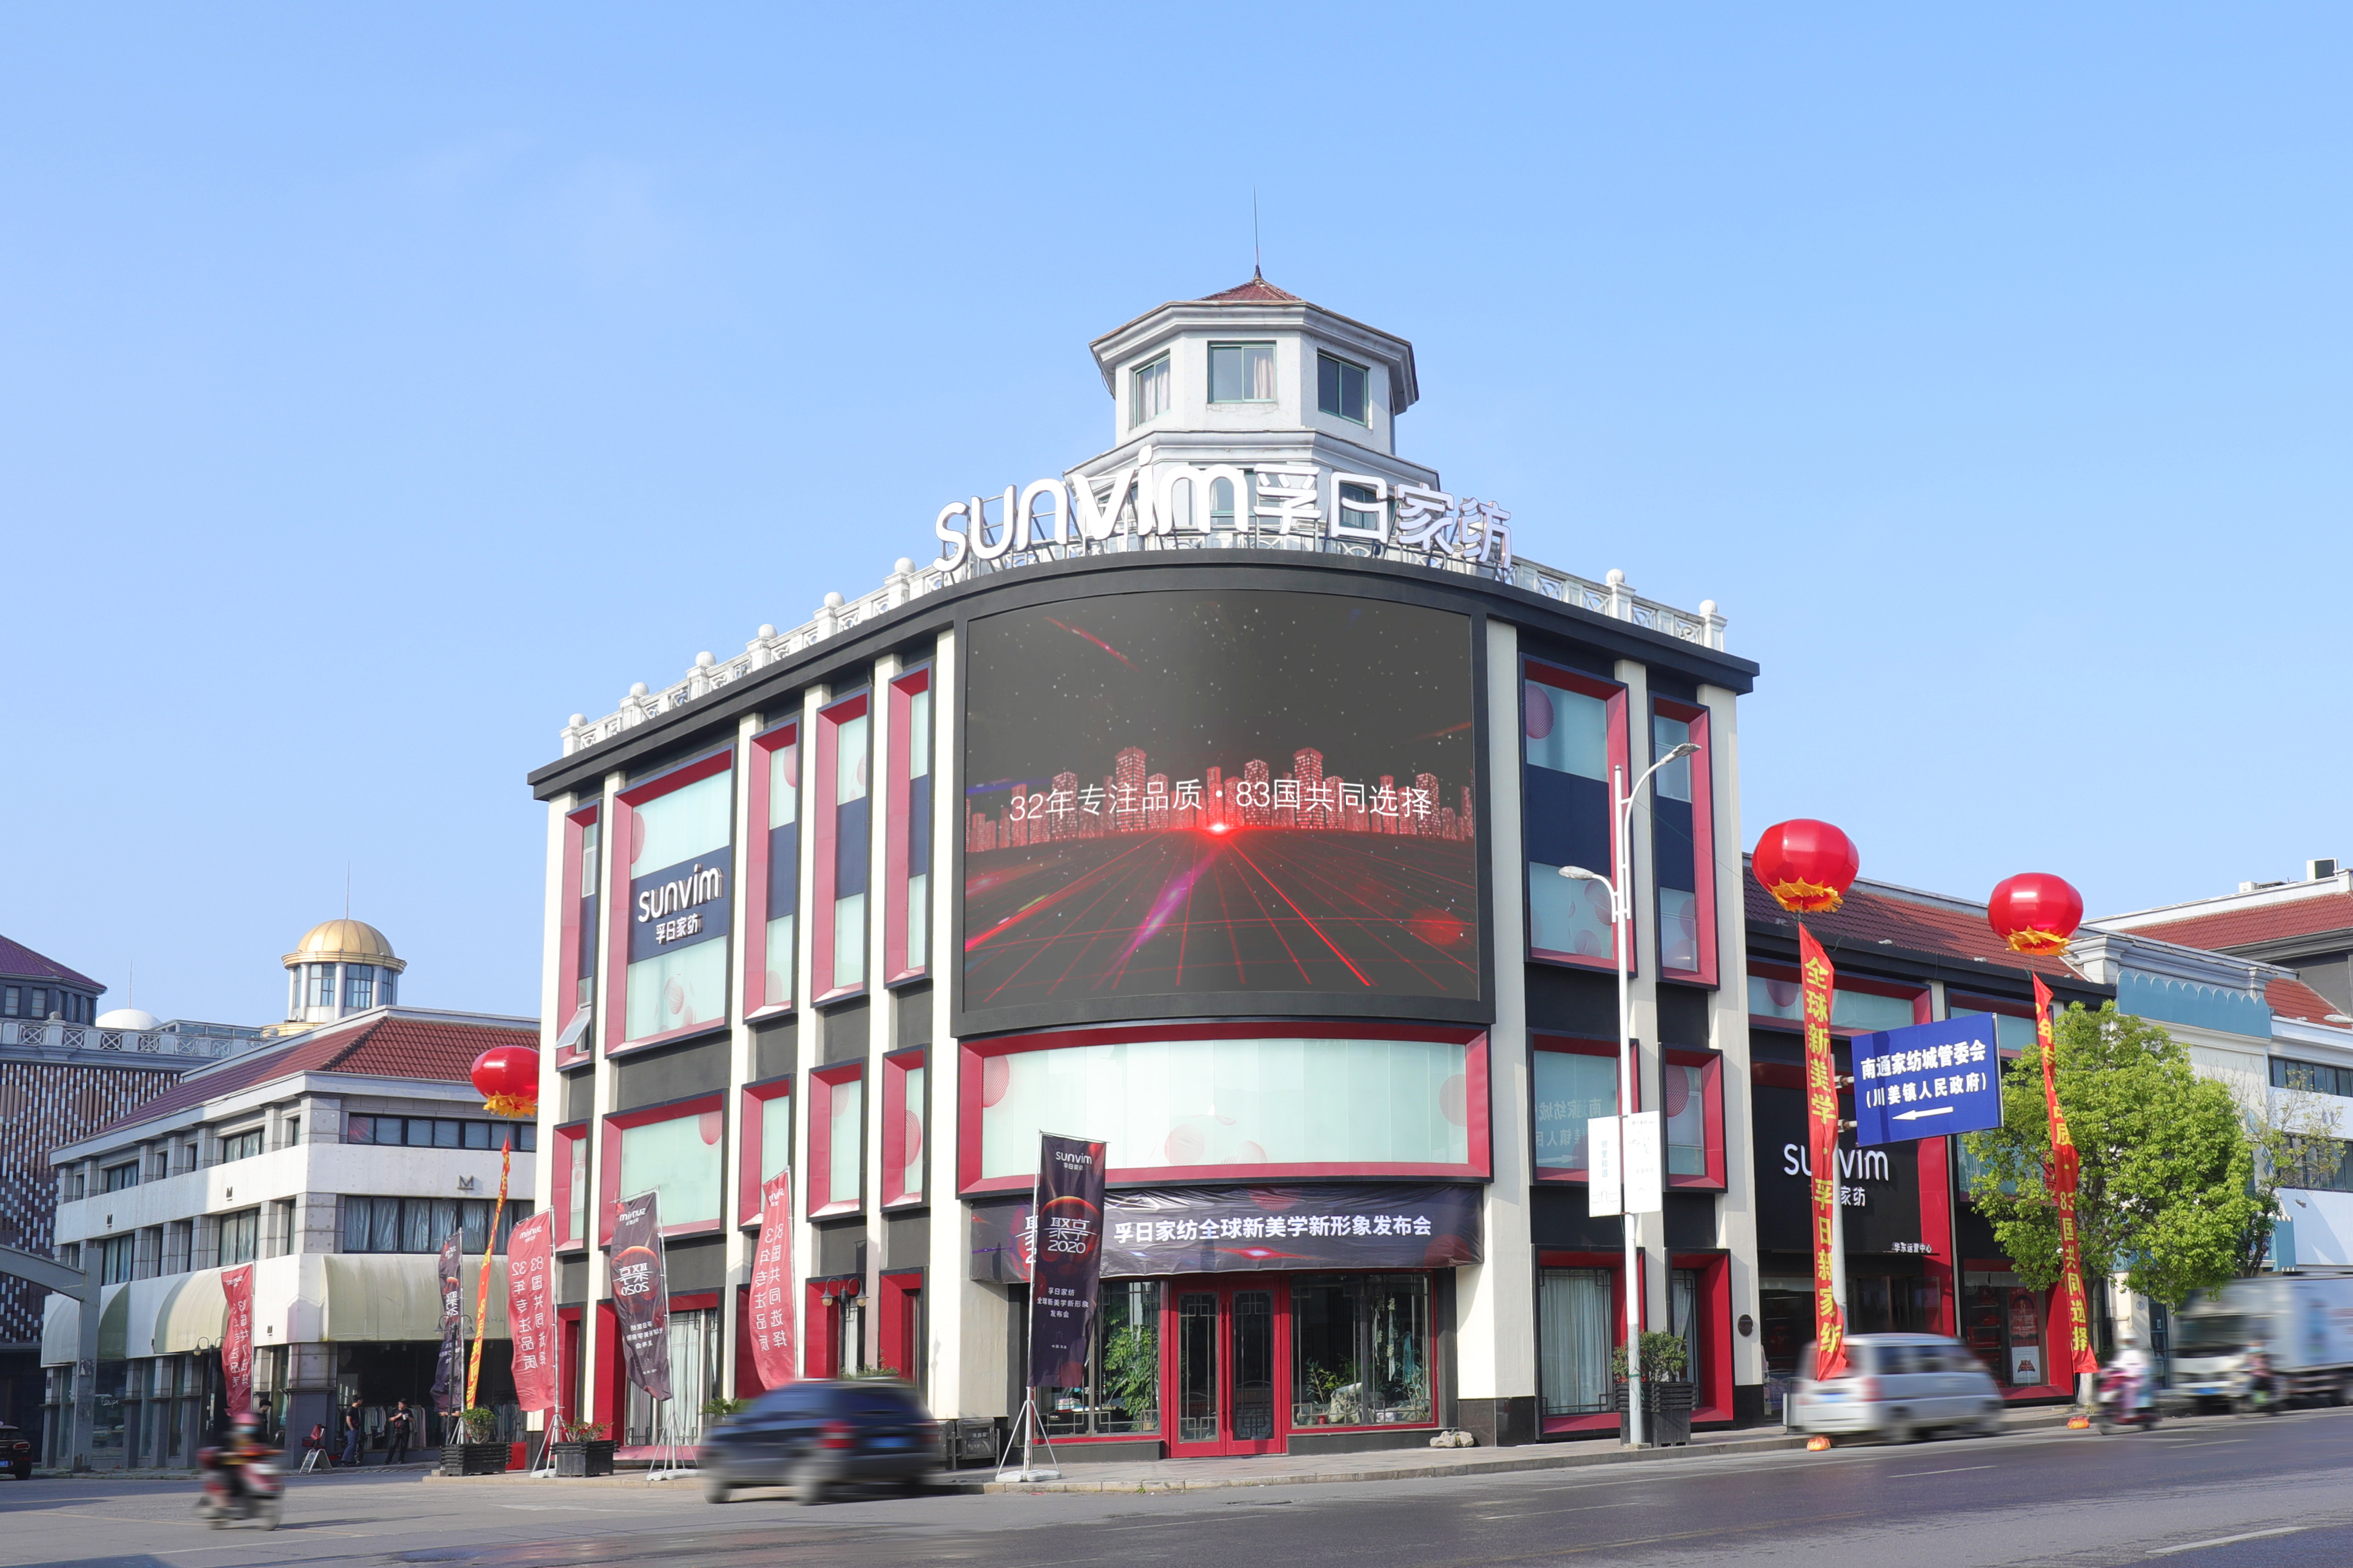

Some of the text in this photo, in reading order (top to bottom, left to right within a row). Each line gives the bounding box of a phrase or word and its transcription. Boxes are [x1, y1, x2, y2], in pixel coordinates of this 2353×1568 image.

[933, 444, 1512, 573] sunvim 孚日家纺
[638, 863, 724, 923] sunvim
[656, 913, 701, 945] 孚日家纺
[1860, 1039, 1986, 1080] 南通家纺城管委会
[1866, 1072, 1988, 1108] (川姜镇人民政府)
[1056, 1151, 1092, 1164] sunvim
[1783, 1143, 1889, 1181] suvim
[1114, 1215, 1433, 1244] 孚日家纺全球新美学新形象发布会
[1047, 1240, 1086, 1254] 2020
[1893, 1241, 1932, 1254] 华东运营中心
[1037, 1297, 1089, 1308] 全球新美学新形象
[1048, 1287, 1075, 1297] 孚日家纺
[1050, 1309, 1070, 1318] 发布会
